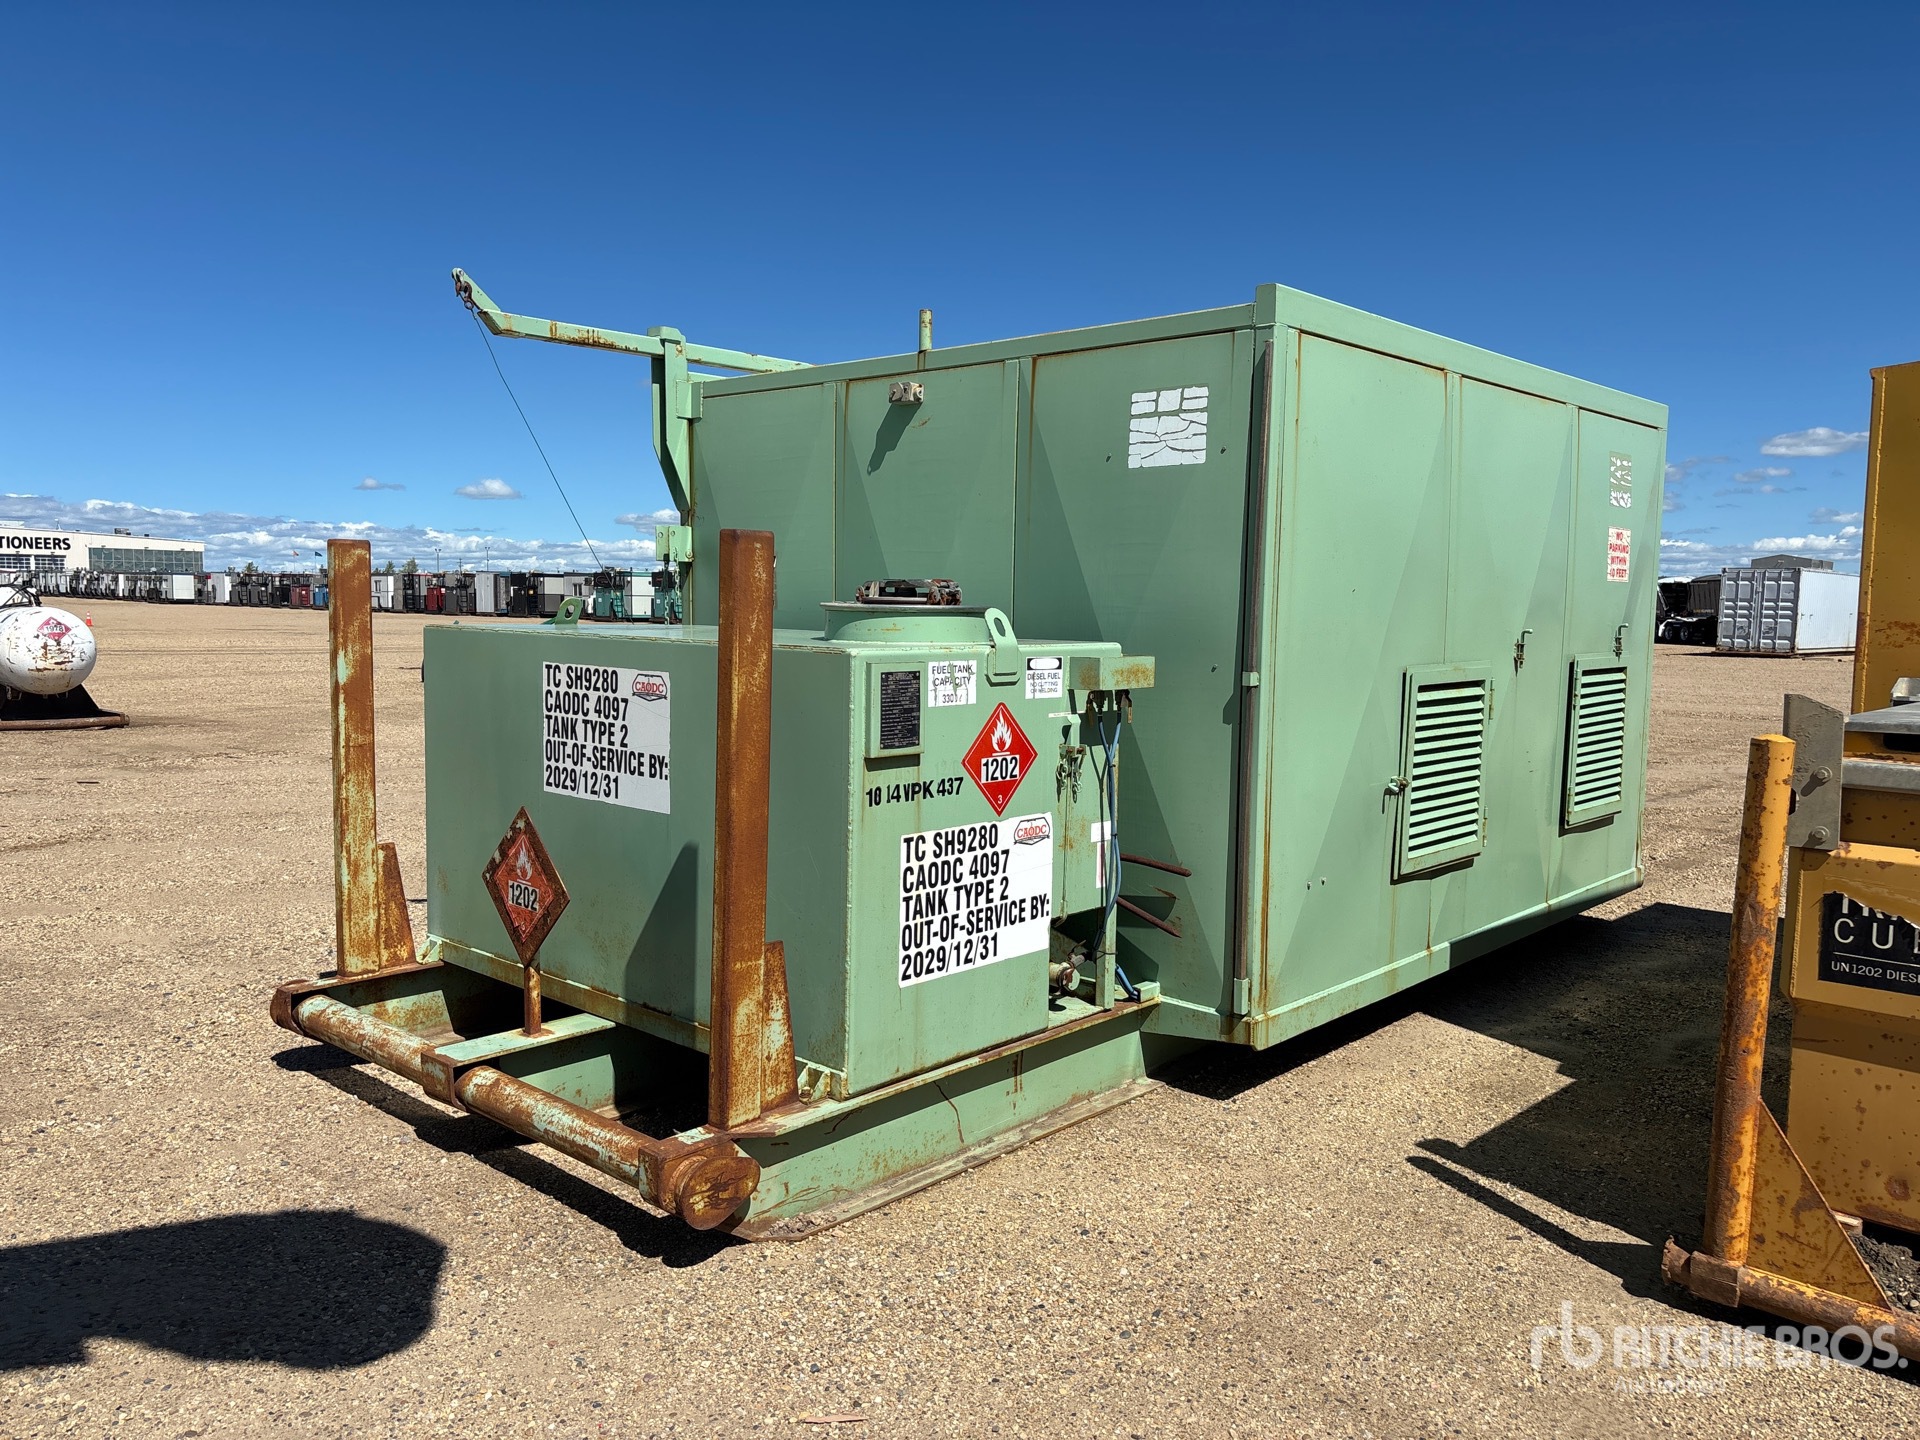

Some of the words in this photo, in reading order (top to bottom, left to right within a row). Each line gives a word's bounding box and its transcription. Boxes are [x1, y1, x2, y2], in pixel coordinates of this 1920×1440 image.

[1609, 543, 1629, 554] PARKING
[1610, 556, 1627, 566] WITHIN
[1616, 568, 1627, 578] FEET
[545, 664, 561, 688] TC
[566, 665, 618, 694] SH9280
[932, 665, 951, 675] FUEL
[953, 664, 973, 674] TANK
[933, 676, 972, 687] CAPACITY
[1027, 672, 1046, 681] DIESEL
[1047, 672, 1061, 680] FUEL
[635, 681, 664, 693] CAODC
[545, 689, 590, 717] CAODC
[594, 695, 629, 721] 4097
[545, 714, 578, 741] TANK
[582, 719, 615, 746] TYPE
[620, 724, 628, 748] 2
[545, 739, 645, 777] OUT-OF-SERVICE
[649, 753, 668, 781] BY:
[982, 756, 1018, 782] 1202
[545, 764, 619, 799] 2029/12/31
[937, 777, 964, 797] 437
[997, 795, 1003, 804] 3
[903, 835, 926, 863] TC
[933, 824, 998, 859] SH9280
[1016, 824, 1047, 838] CAODC
[903, 857, 963, 893] CAODC
[969, 849, 1010, 879] 4097
[509, 882, 538, 912] 1202
[903, 888, 948, 922] TANK
[954, 879, 994, 911] TYPE
[1000, 876, 1009, 901] 2
[902, 899, 1026, 952] OUT-OF-SERVICE
[1031, 893, 1050, 920] BY:
[901, 932, 998, 981] 2029/12/31
